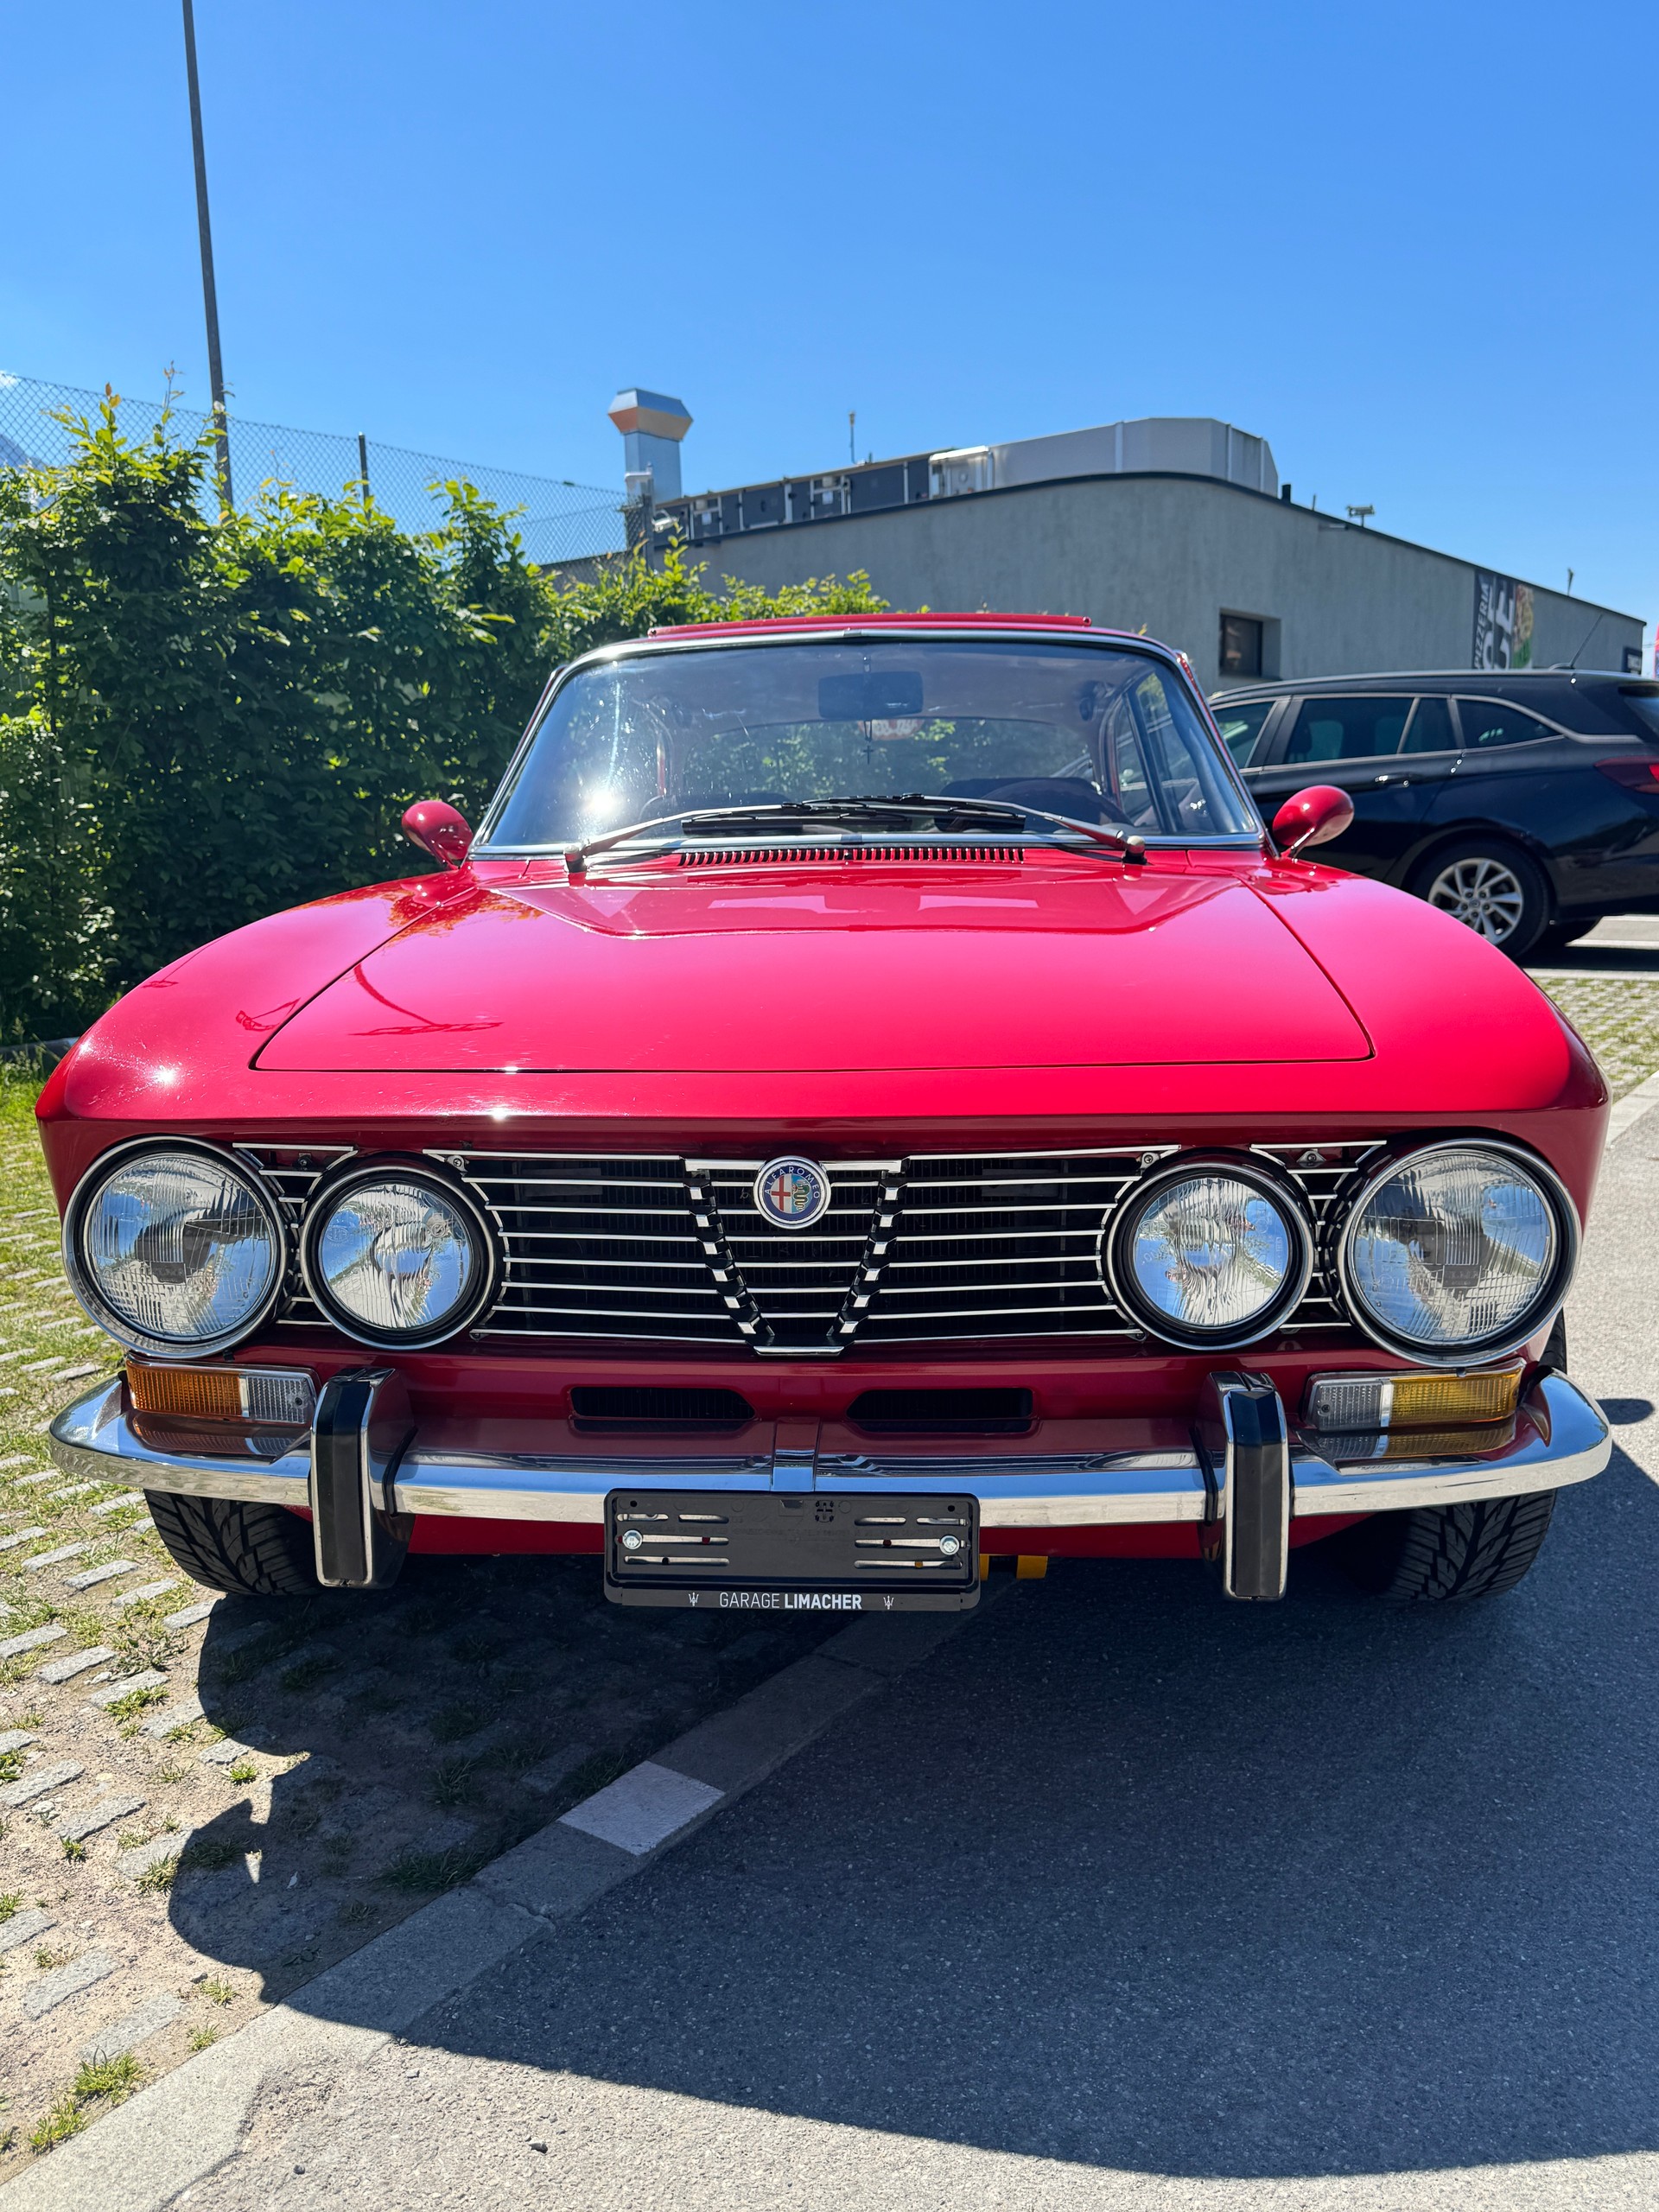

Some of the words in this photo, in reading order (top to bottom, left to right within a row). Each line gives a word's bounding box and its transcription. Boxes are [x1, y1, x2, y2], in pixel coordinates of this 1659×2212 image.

[1474, 582, 1490, 670] PIZZERIA
[719, 1592, 780, 1608] GARAGE
[784, 1593, 862, 1610] LIMACHER
